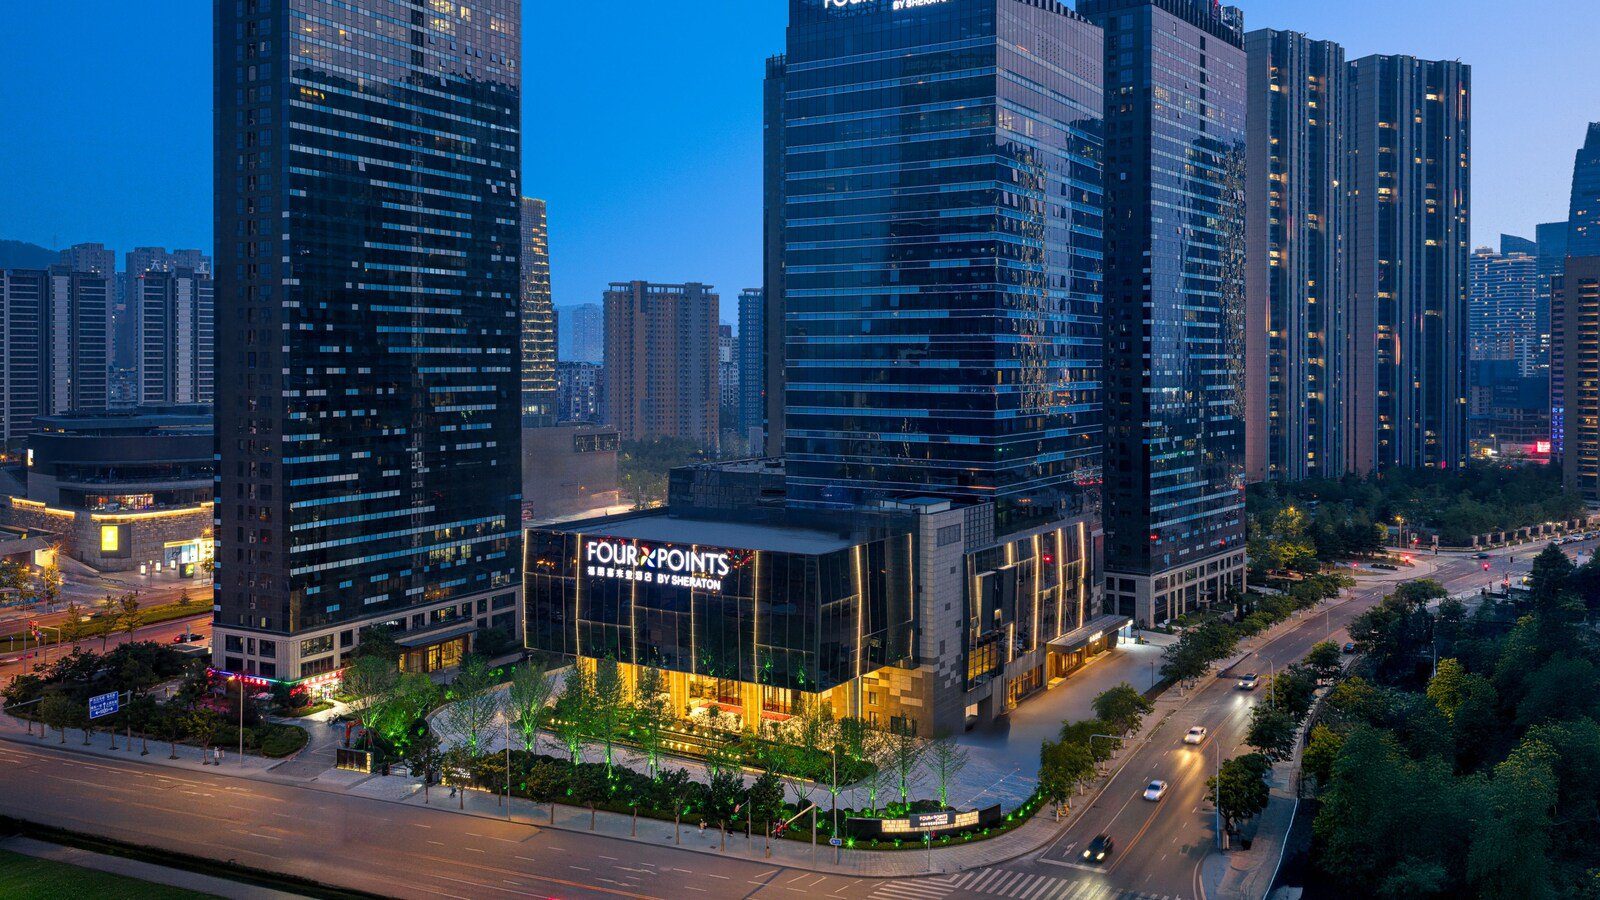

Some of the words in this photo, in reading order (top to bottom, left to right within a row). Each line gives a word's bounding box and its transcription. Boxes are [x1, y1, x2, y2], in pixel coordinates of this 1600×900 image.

[892, 0, 904, 10] BY
[587, 542, 638, 566] FOUR
[657, 548, 730, 576] POINTS
[657, 573, 670, 584] BY
[671, 575, 721, 590] SHERATON
